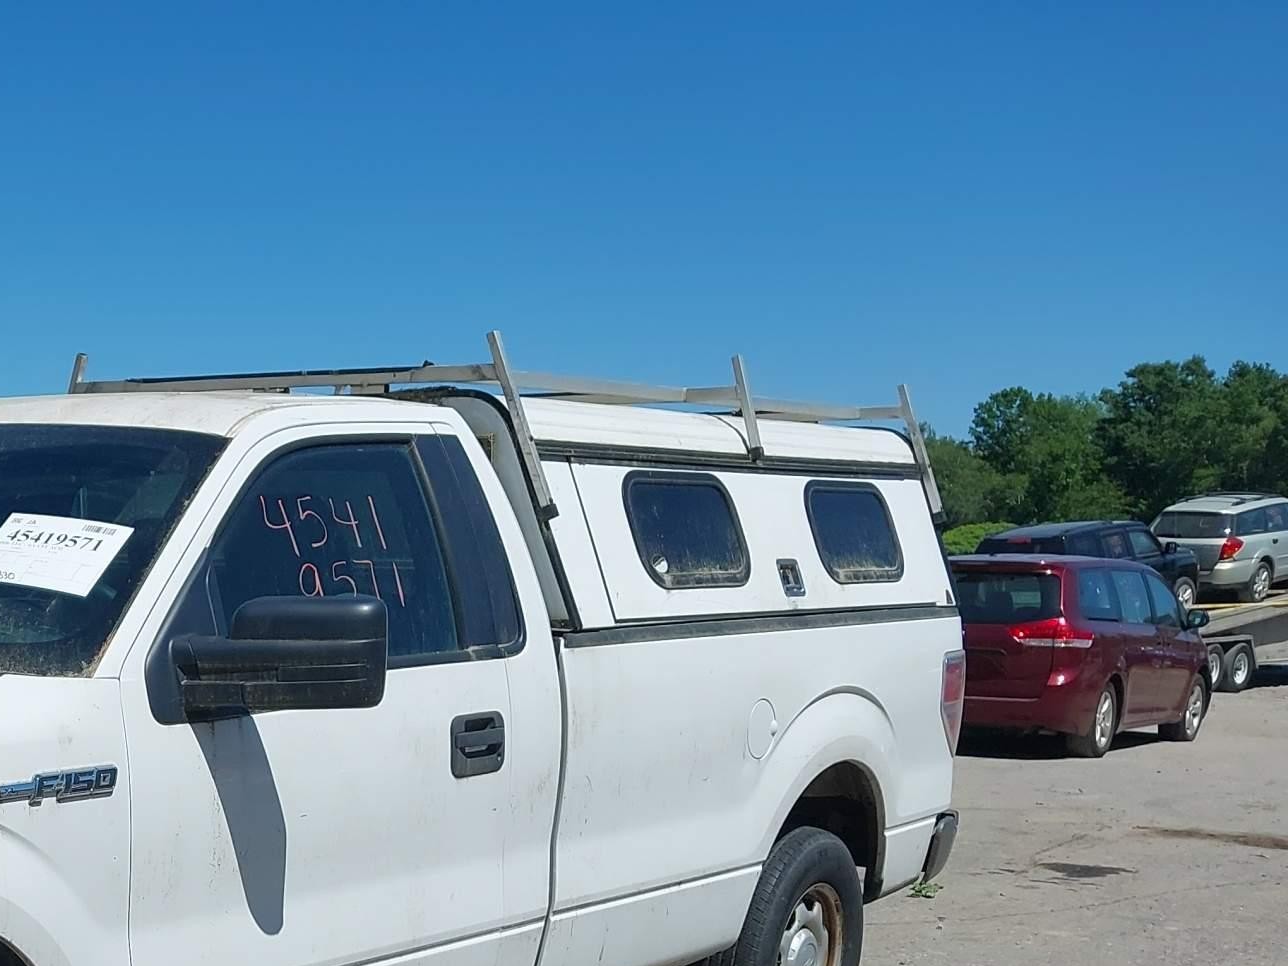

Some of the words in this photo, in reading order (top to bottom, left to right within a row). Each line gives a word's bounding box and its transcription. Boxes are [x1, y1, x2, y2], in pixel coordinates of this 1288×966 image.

[6, 529, 104, 552] 45419571
[259, 494, 389, 557] 4541
[298, 559, 406, 608] 9571
[29, 764, 118, 807] F-150
